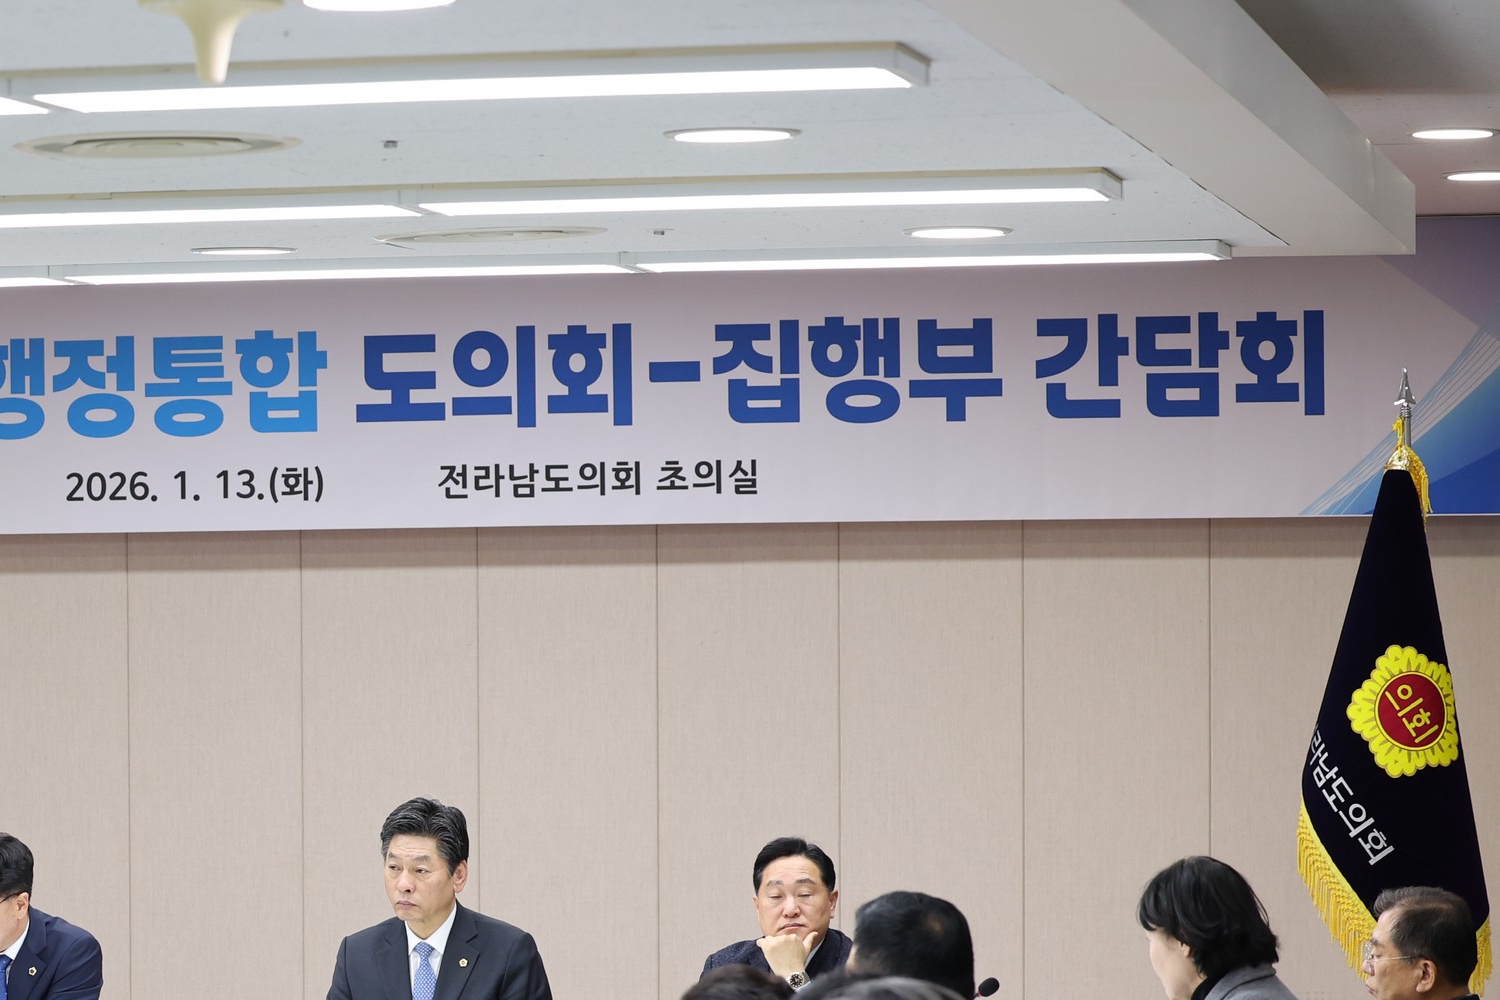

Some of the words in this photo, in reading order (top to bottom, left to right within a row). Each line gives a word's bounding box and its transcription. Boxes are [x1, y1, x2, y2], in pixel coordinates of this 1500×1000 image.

[356, 317, 1003, 428] 도의회-집행부
[1036, 310, 1325, 418] 간담회
[66, 471, 158, 502] 2026.
[173, 470, 200, 501] 1.
[216, 466, 324, 503] 13.(화)
[438, 461, 641, 499] 전라남도의회
[656, 459, 758, 495] 초의실
[1384, 683, 1439, 743] 의회
[1309, 727, 1395, 866] 라남도의회
